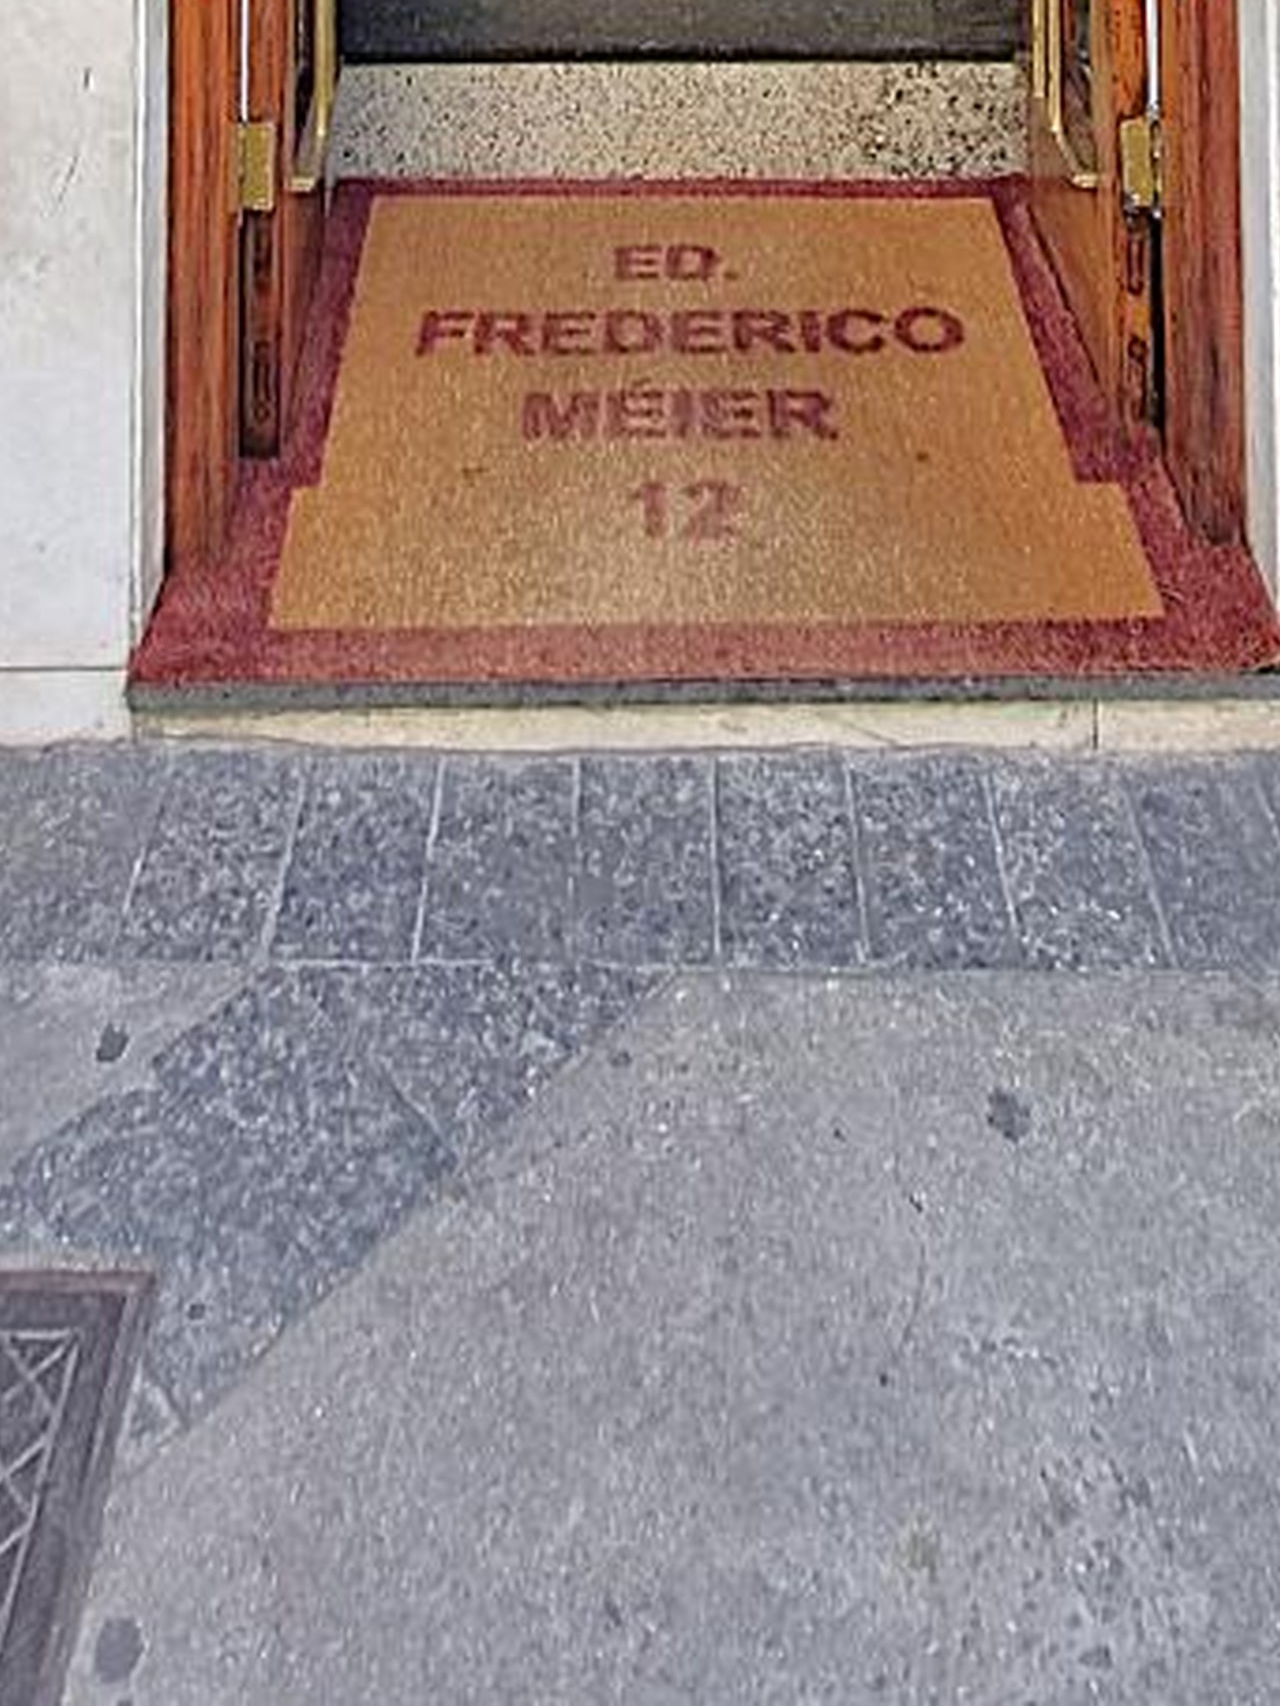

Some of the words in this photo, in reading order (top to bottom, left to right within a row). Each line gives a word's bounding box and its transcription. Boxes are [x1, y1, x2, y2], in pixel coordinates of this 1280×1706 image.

[613, 243, 739, 282] ED.
[414, 306, 966, 357] FREDERICO
[628, 479, 741, 542] 12
